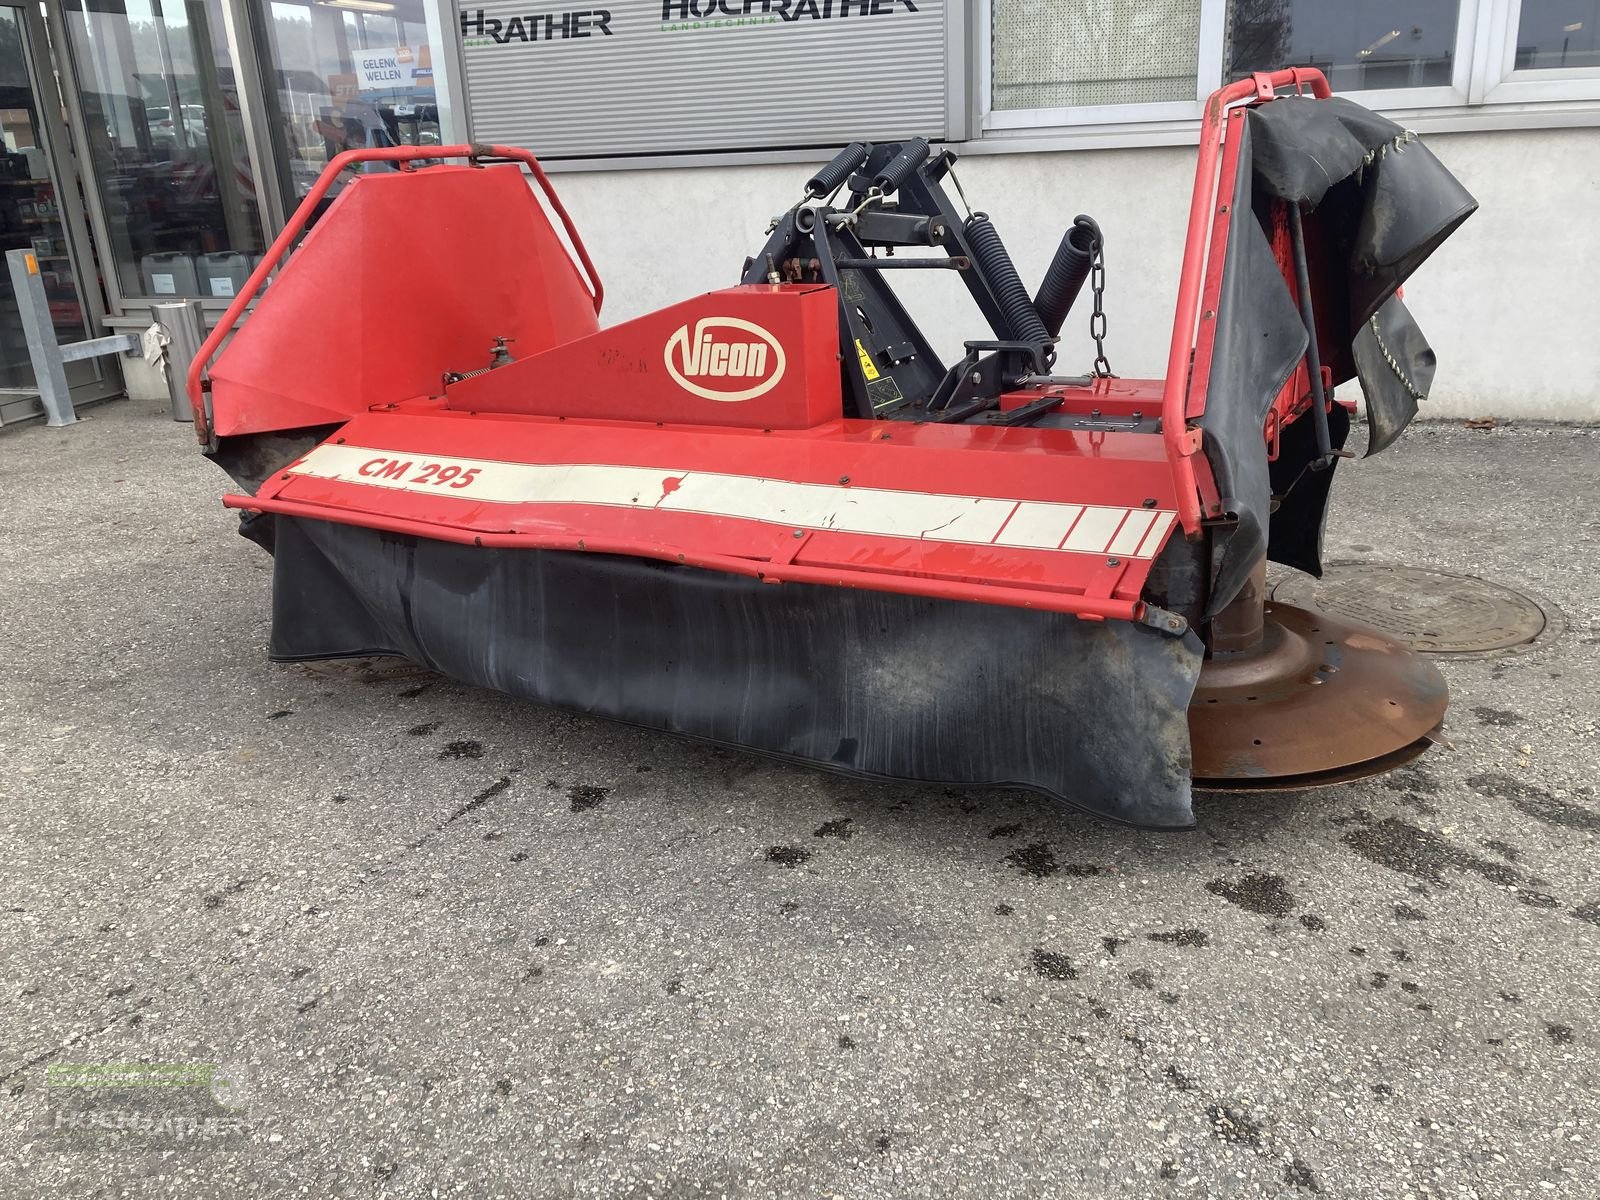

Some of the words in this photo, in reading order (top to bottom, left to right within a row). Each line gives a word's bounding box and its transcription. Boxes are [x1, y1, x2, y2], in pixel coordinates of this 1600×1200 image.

[661, 16, 777, 32] LANDTECHNIK
[362, 58, 397, 70] GELENK
[365, 69, 402, 81] WELLEN
[358, 458, 413, 480] CM
[409, 463, 482, 489] 295
